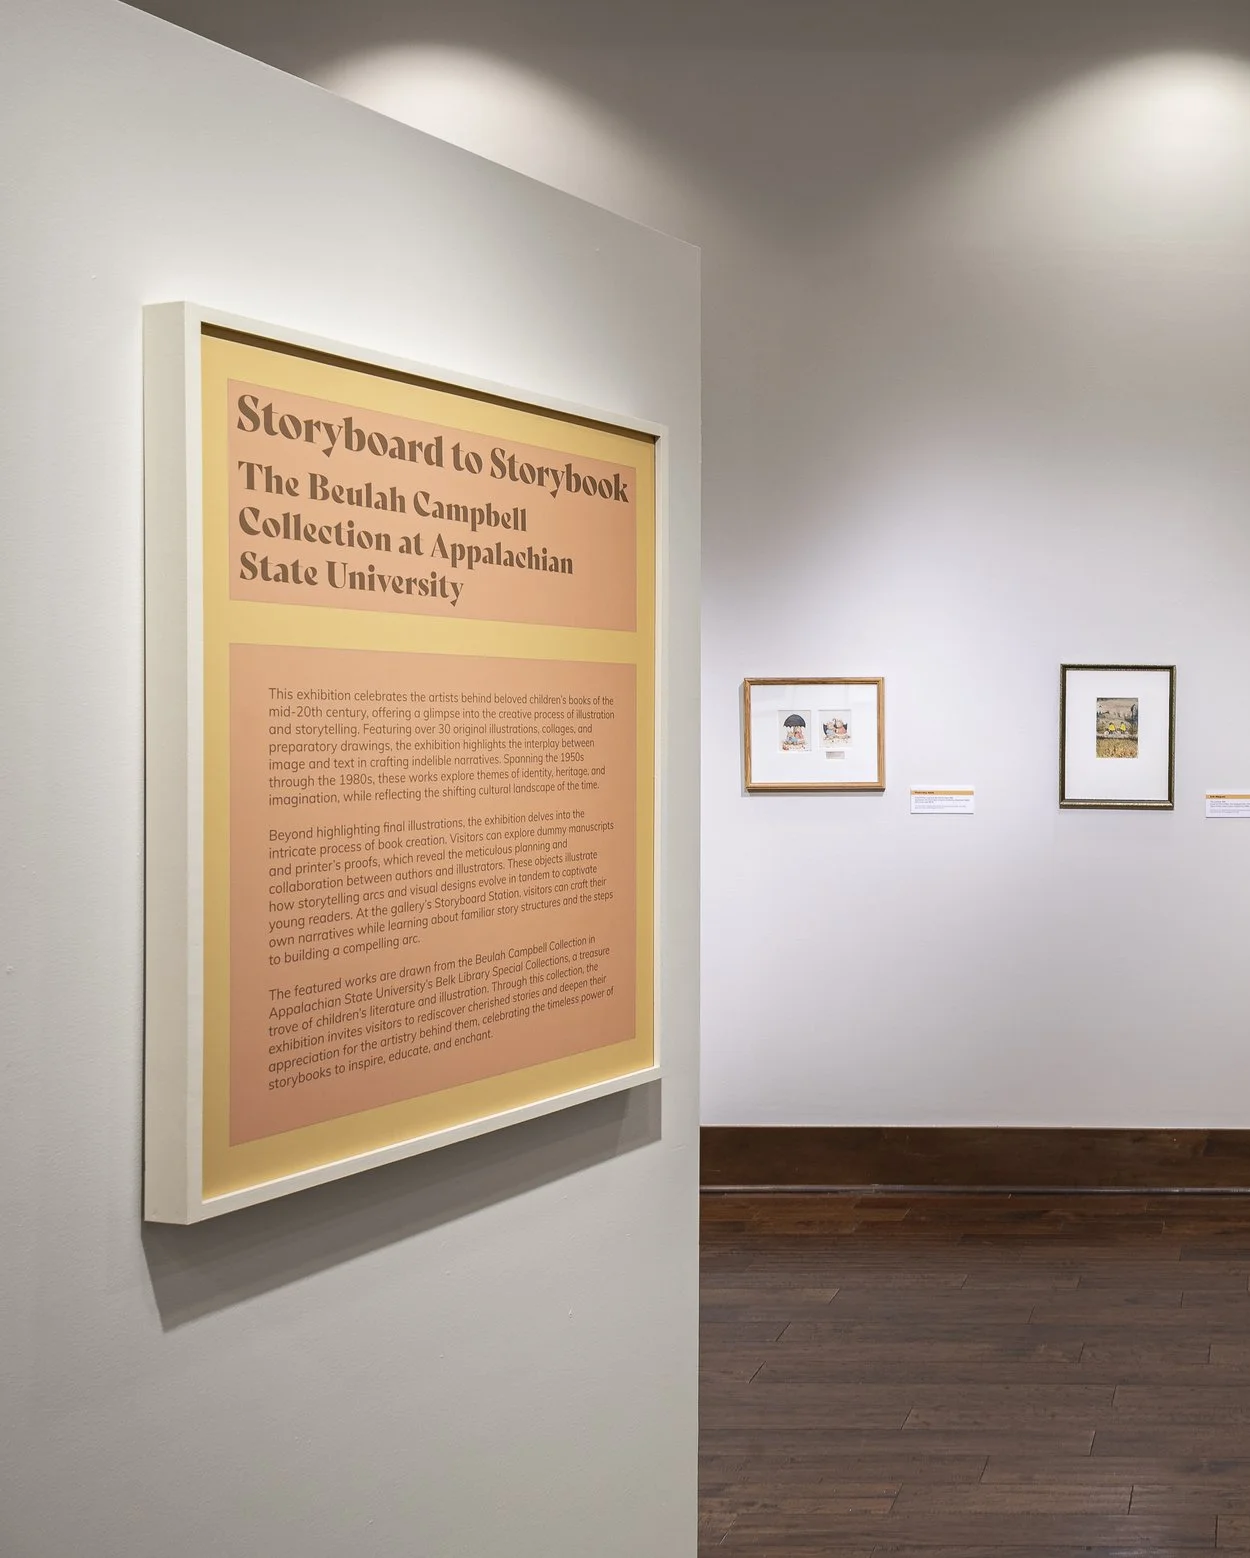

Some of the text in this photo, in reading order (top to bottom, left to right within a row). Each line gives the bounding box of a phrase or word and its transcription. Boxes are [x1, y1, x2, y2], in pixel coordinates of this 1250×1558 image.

[237, 394, 629, 504] Storyboard to Storybook
[238, 460, 526, 532] The Beulah Campbell
[239, 506, 573, 574] Collection at Appalachian
[240, 552, 463, 606] State University
[268, 705, 614, 721] mid-20th century, offering glimpse creative process illustration
[269, 687, 566, 704] This exhibition celebrates artists behind beloved children's
[268, 723, 575, 737] and storytelling. Featuring original illustrations, collages,
[268, 738, 594, 755] preparatory drawings, exhibition highlights interplay between
[268, 751, 584, 772] image and crafting indelible narratives. Spanning 1950s
[269, 766, 589, 790] through 1980s, these works explore themes identity, heritage,
[269, 782, 555, 807] imagination, while reflecting shifting cultural landscape
[269, 811, 553, 843] Beyond highlighting final illustrations, exhibition delves
[269, 820, 613, 859] intricate process book creation. Visitors explore dummy manuscripts
[268, 840, 550, 877] and printer's proofs, which reveal meticulous planning
[268, 849, 597, 894] collaboration between authors illustrators. These objects illustrate
[268, 865, 597, 912] how storytelling and visual designs evolve tandem captivate
[268, 885, 552, 933] young readers. gallery's Storyboard Station, visitors
[268, 897, 560, 948] own narratives while learning about familiar structures
[269, 936, 586, 1000] The featured works drawn from Beulah Campbell Collection
[284, 937, 399, 963] building compelling
[268, 946, 609, 1020] Appalachian State University's Belk Library Special Collections, treasure
[268, 966, 584, 1036] trove children's literature illustration. Through collection,
[268, 979, 587, 1054] exhibition invites visitors rediscover cherished stories deepen
[268, 990, 605, 1074] appreciation artistry behind them, celebrating timeless power
[268, 1029, 492, 1090] storybooks inspire, educate, and enchant.
